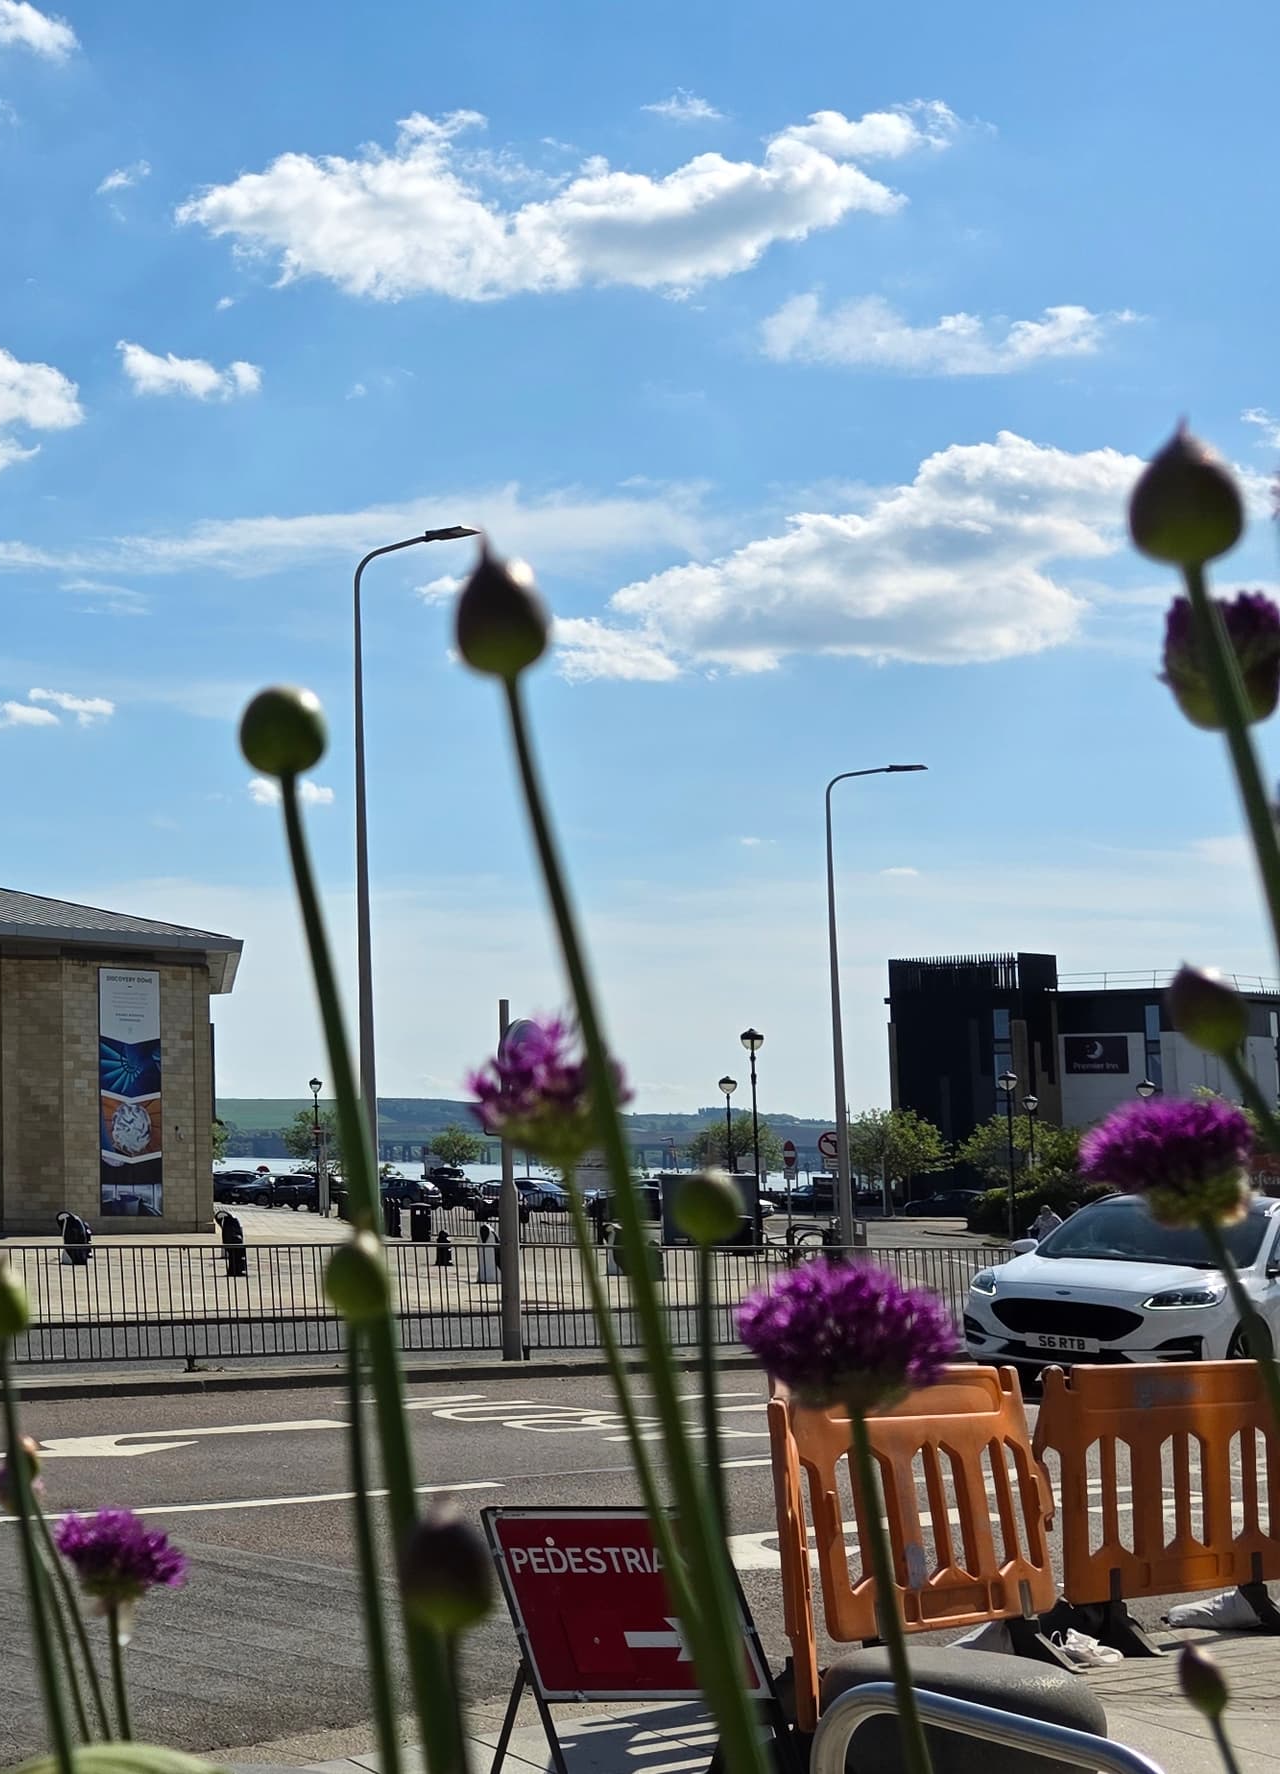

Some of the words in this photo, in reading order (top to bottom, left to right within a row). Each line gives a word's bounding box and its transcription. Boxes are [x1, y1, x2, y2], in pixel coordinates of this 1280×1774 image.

[106, 975, 136, 983] DISCOVERY
[1105, 1062, 1119, 1070] Inn
[1038, 1335, 1056, 1347] S6
[1059, 1337, 1086, 1350] RTB
[509, 1546, 668, 1575] PEDESTRIA
